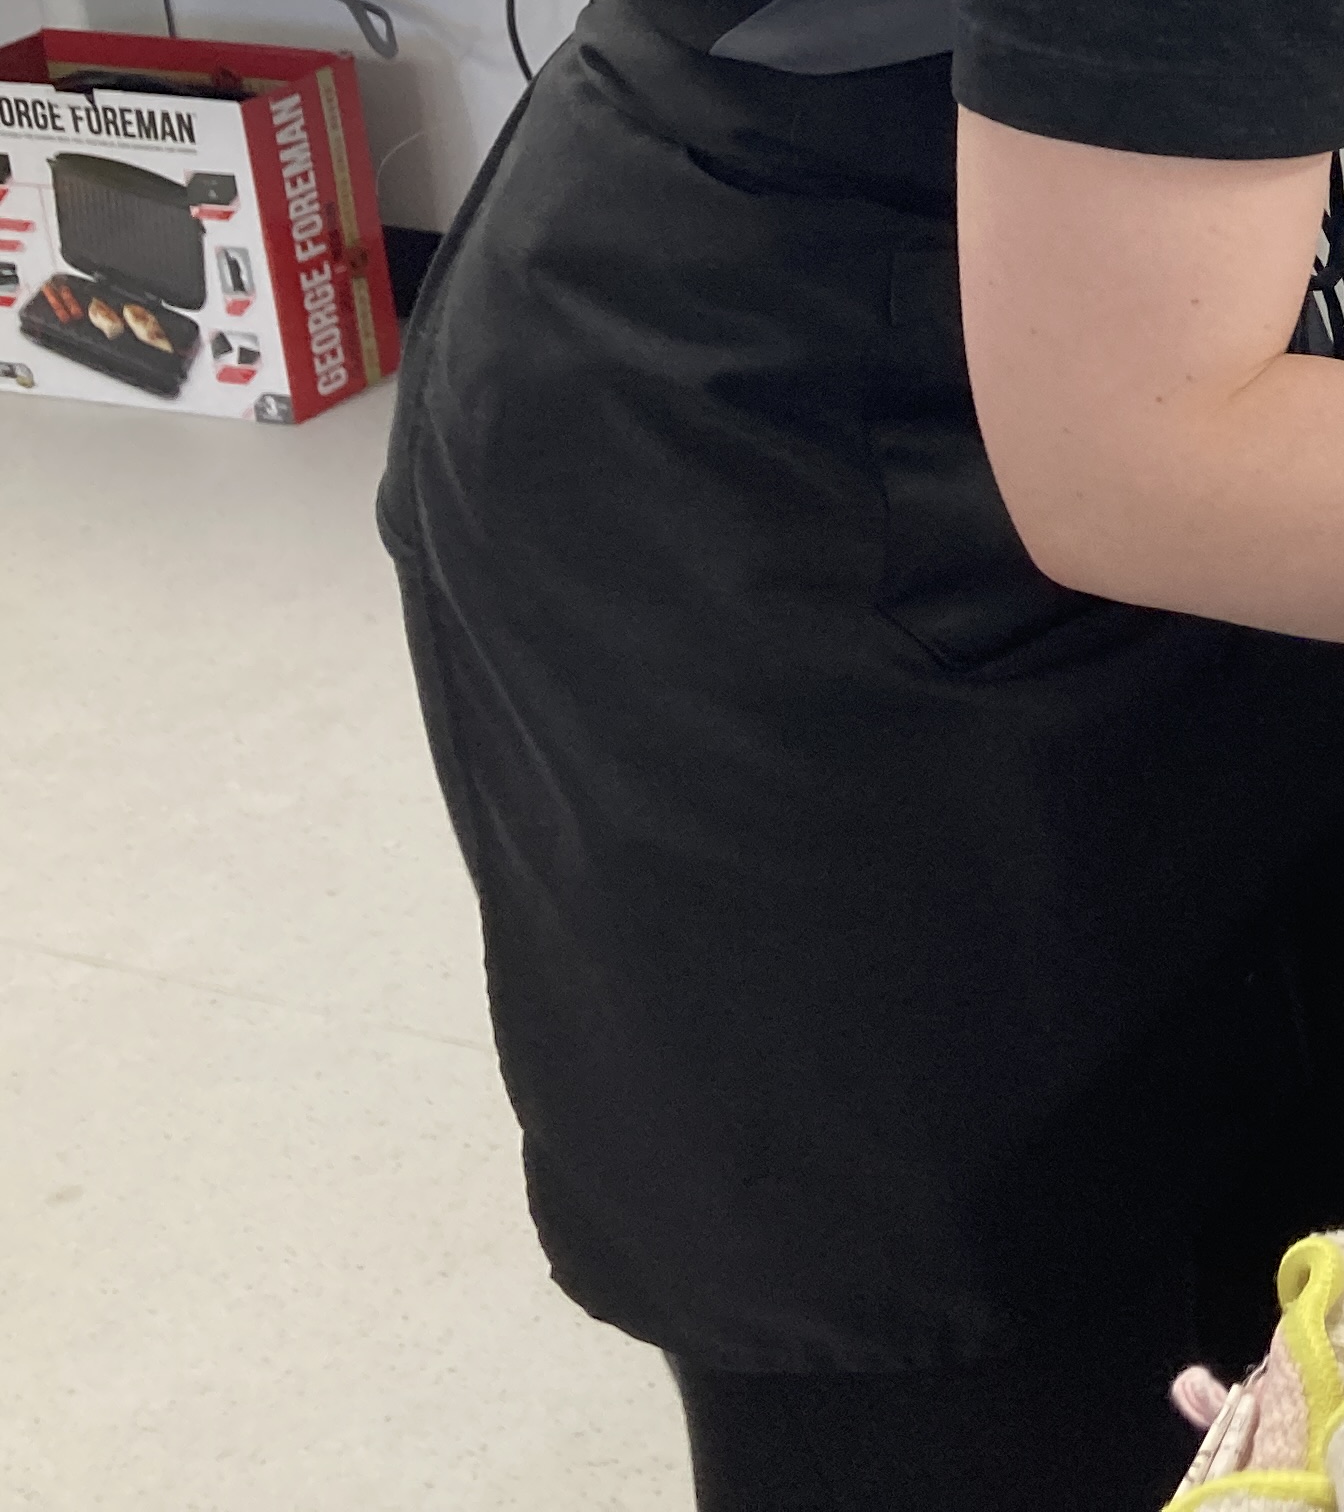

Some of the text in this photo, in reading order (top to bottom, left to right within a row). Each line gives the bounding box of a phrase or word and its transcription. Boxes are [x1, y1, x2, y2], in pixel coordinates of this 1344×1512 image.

[0, 96, 197, 145] ORGE FOREMAN
[269, 92, 348, 396] GEORGE FOREMAN
